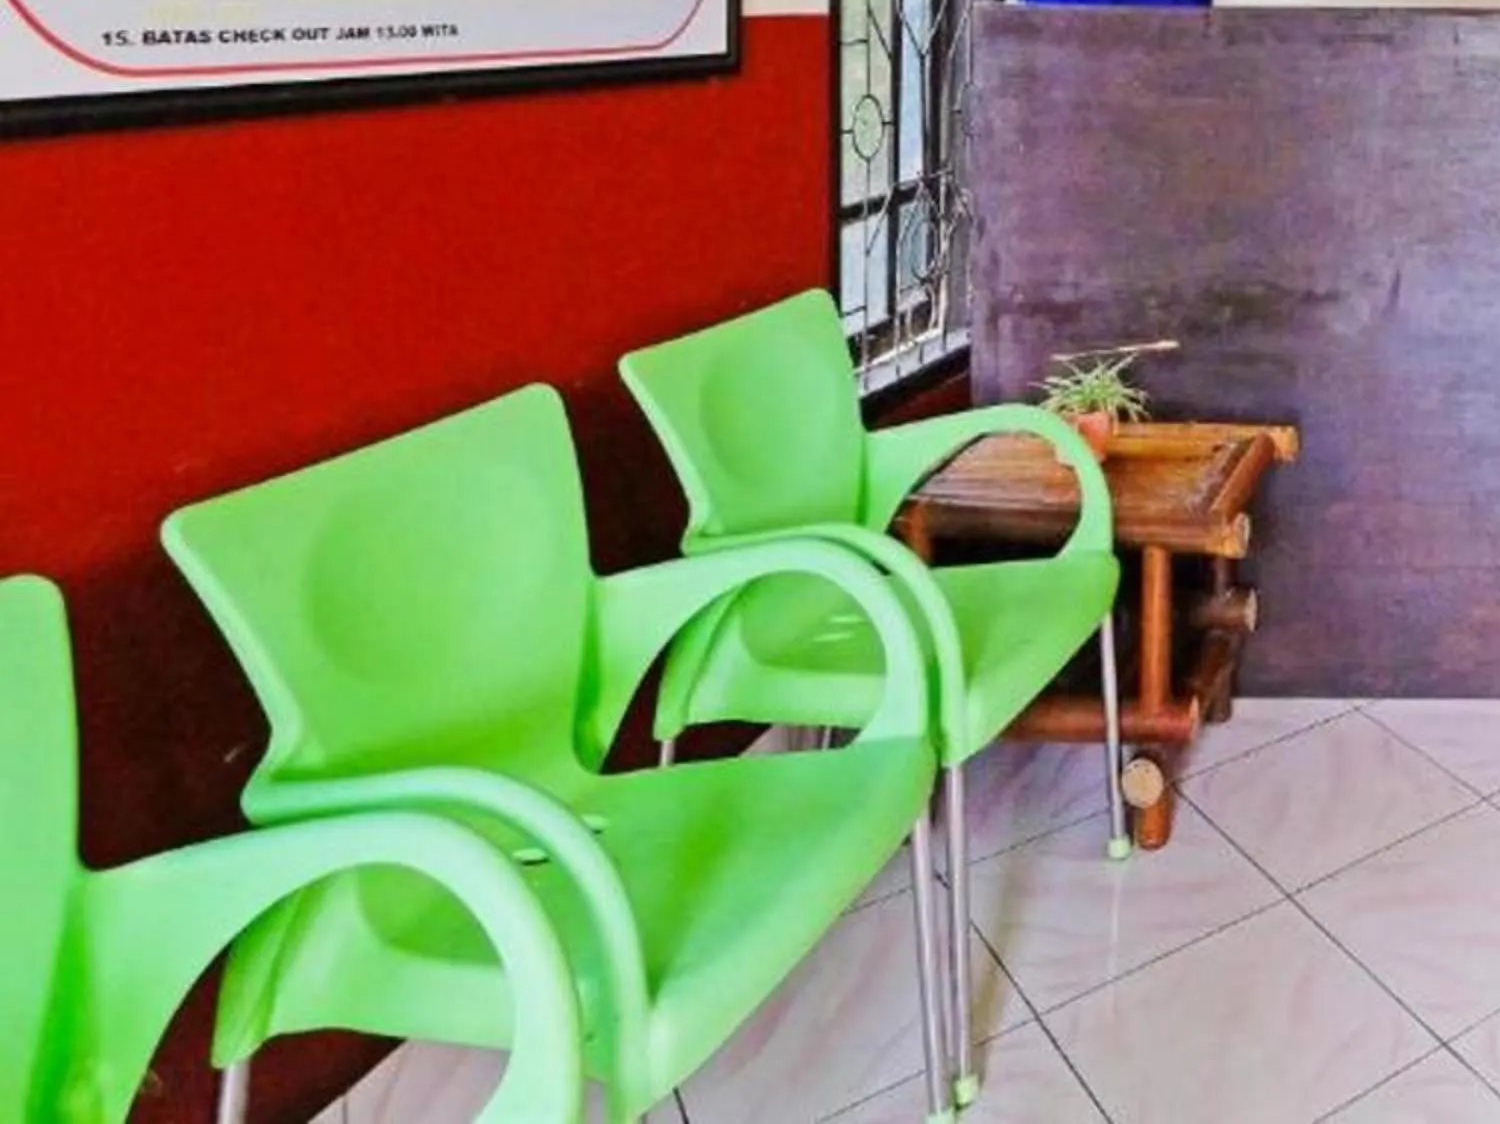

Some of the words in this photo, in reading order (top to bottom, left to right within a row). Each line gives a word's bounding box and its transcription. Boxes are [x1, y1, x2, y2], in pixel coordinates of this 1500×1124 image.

[141, 29, 213, 47] BATAS
[217, 27, 286, 45] CHECK
[291, 26, 331, 42] OUT
[335, 25, 371, 41] JAM
[421, 22, 460, 38] WITA
